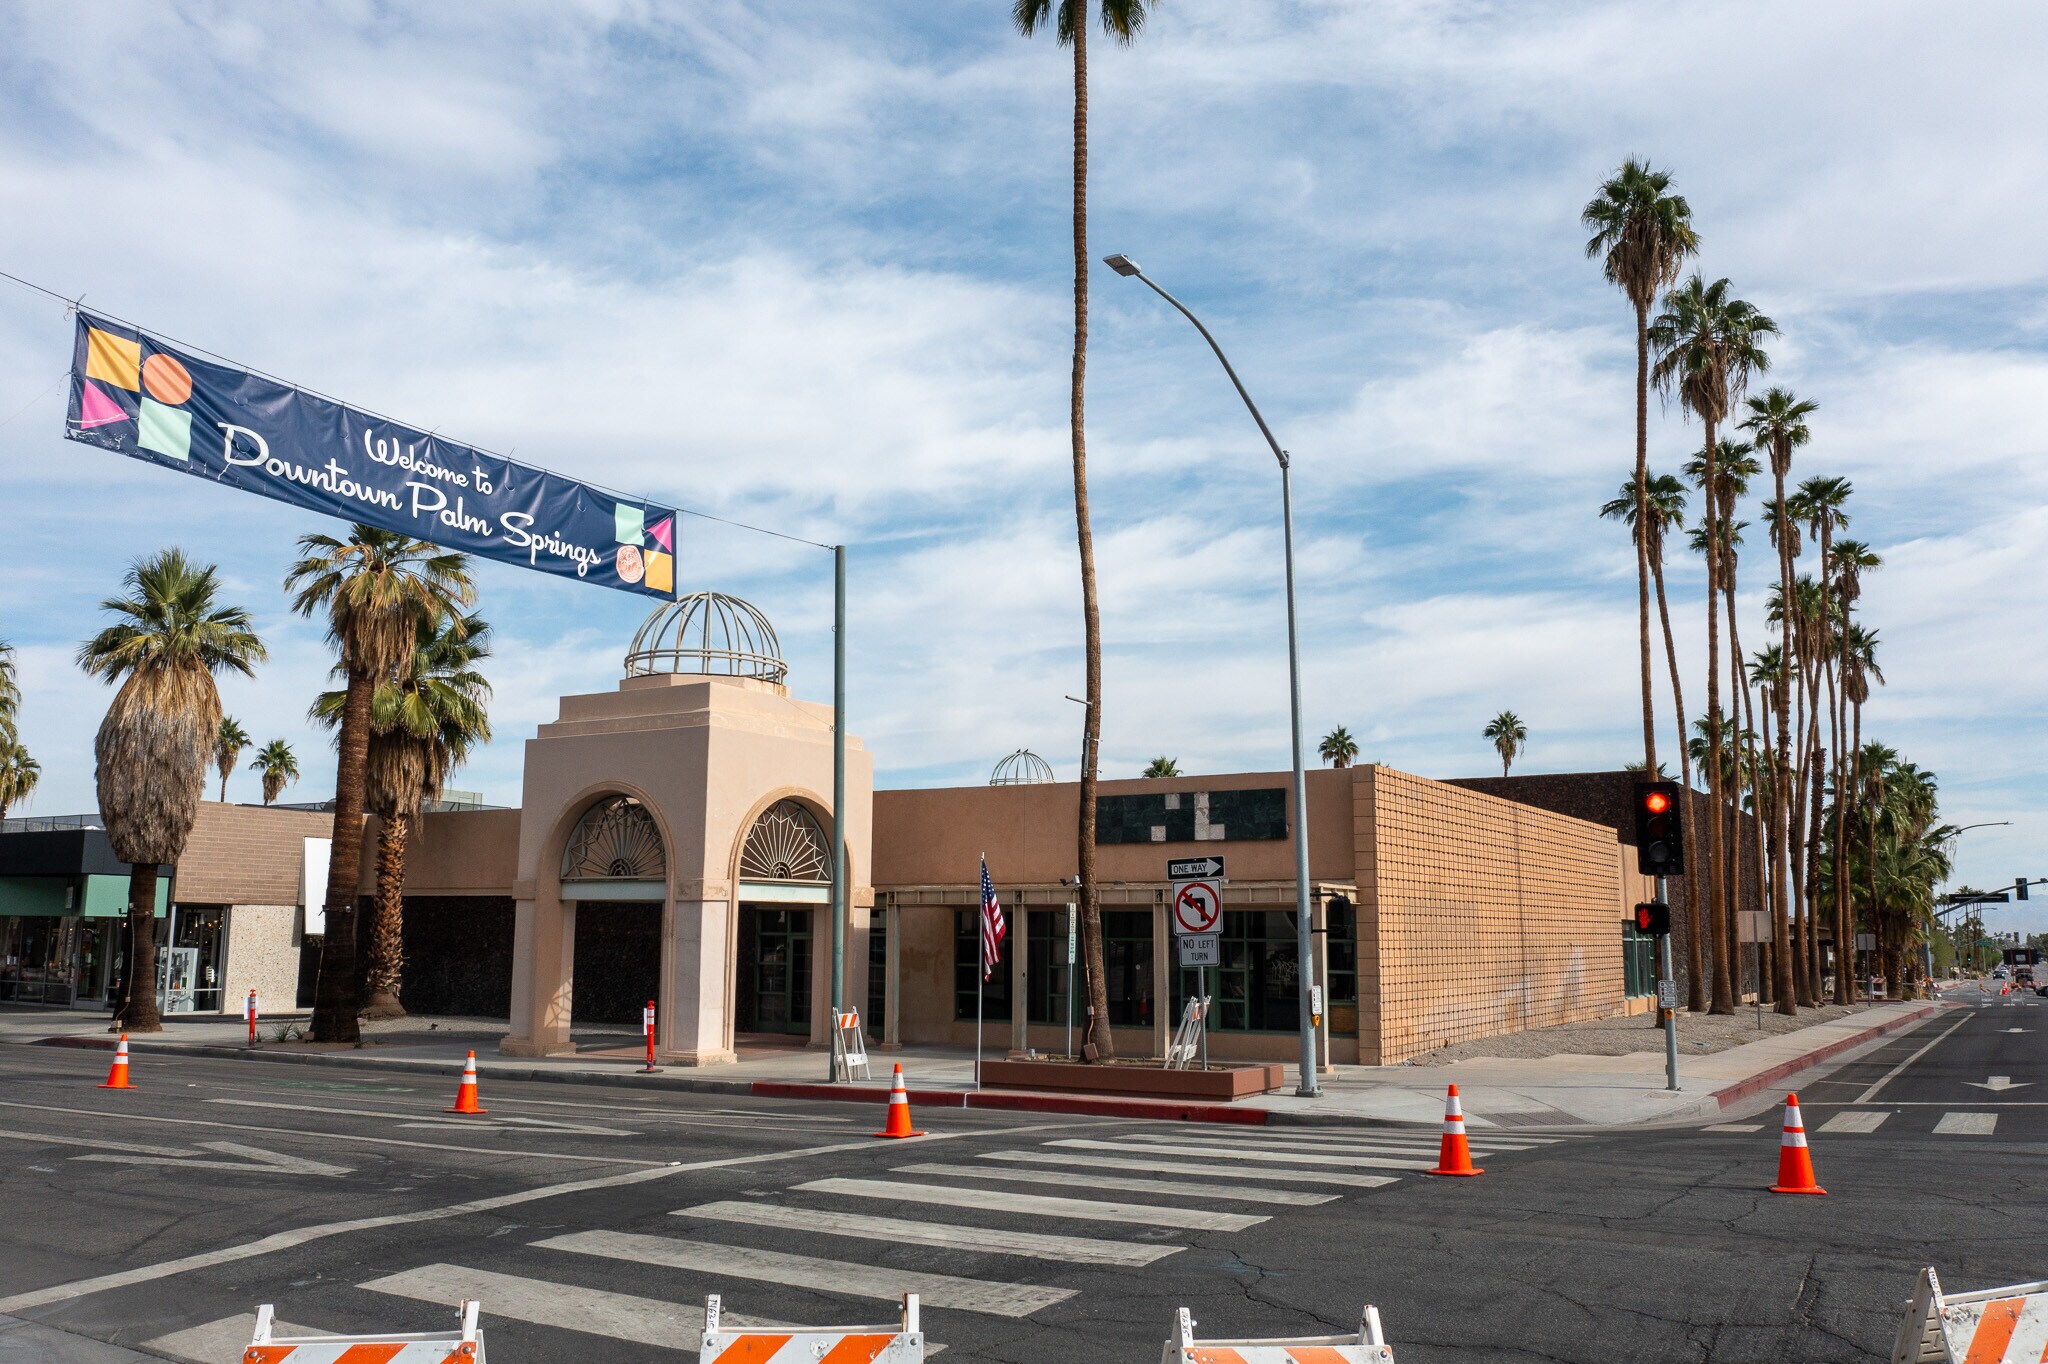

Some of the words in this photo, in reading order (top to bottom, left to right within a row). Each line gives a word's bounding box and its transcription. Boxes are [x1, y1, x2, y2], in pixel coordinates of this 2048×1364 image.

[364, 429, 469, 487] Welcome
[472, 466, 493, 495] to
[218, 422, 402, 511] Downtown
[406, 482, 492, 537] Palm
[500, 512, 601, 577] Springs
[1173, 864, 1189, 874] ONE
[1191, 863, 1207, 873] WAY
[1182, 938, 1195, 949] NO
[1198, 939, 1215, 949] LEFT
[1191, 952, 1208, 961] TURN
